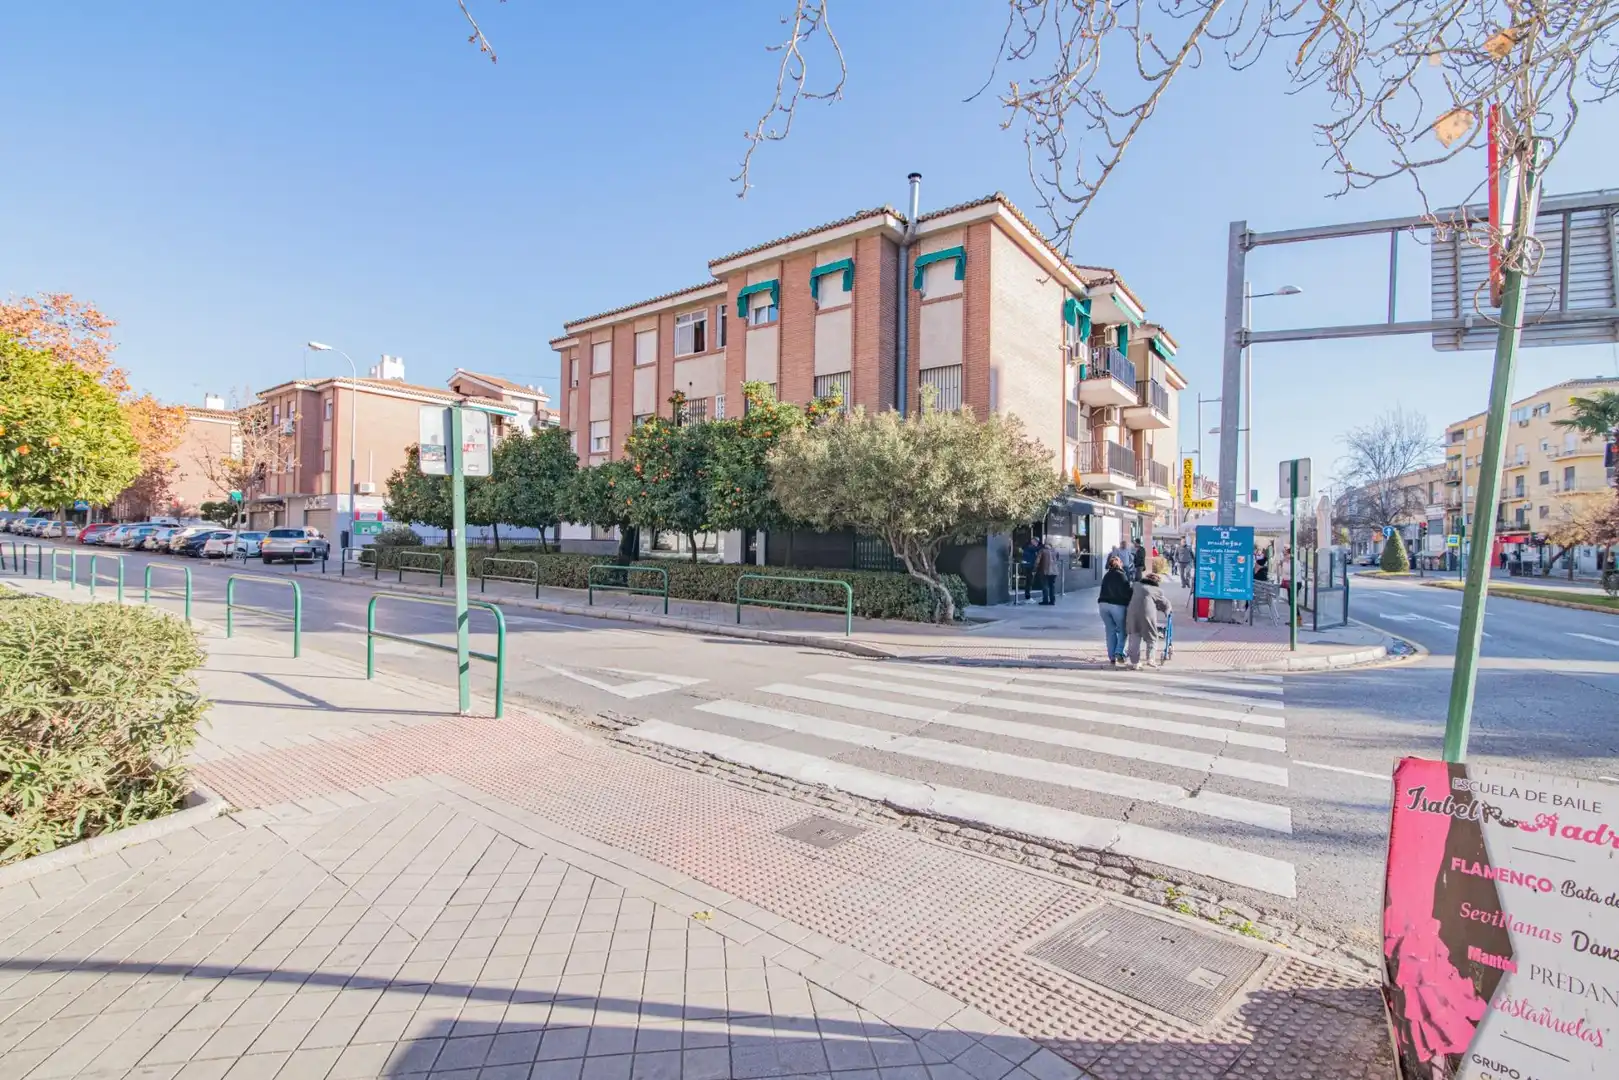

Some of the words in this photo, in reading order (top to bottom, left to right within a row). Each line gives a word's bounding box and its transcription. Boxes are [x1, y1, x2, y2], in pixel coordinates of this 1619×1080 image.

[1406, 785, 1480, 820] Isabel
[1452, 777, 1520, 799] ESCUELA
[1525, 789, 1548, 804] DE
[1552, 794, 1603, 814] BAILE
[1560, 879, 1603, 904] Bata
[1459, 902, 1563, 944] Sevillanas
[1471, 1053, 1521, 1080] GRUPO
